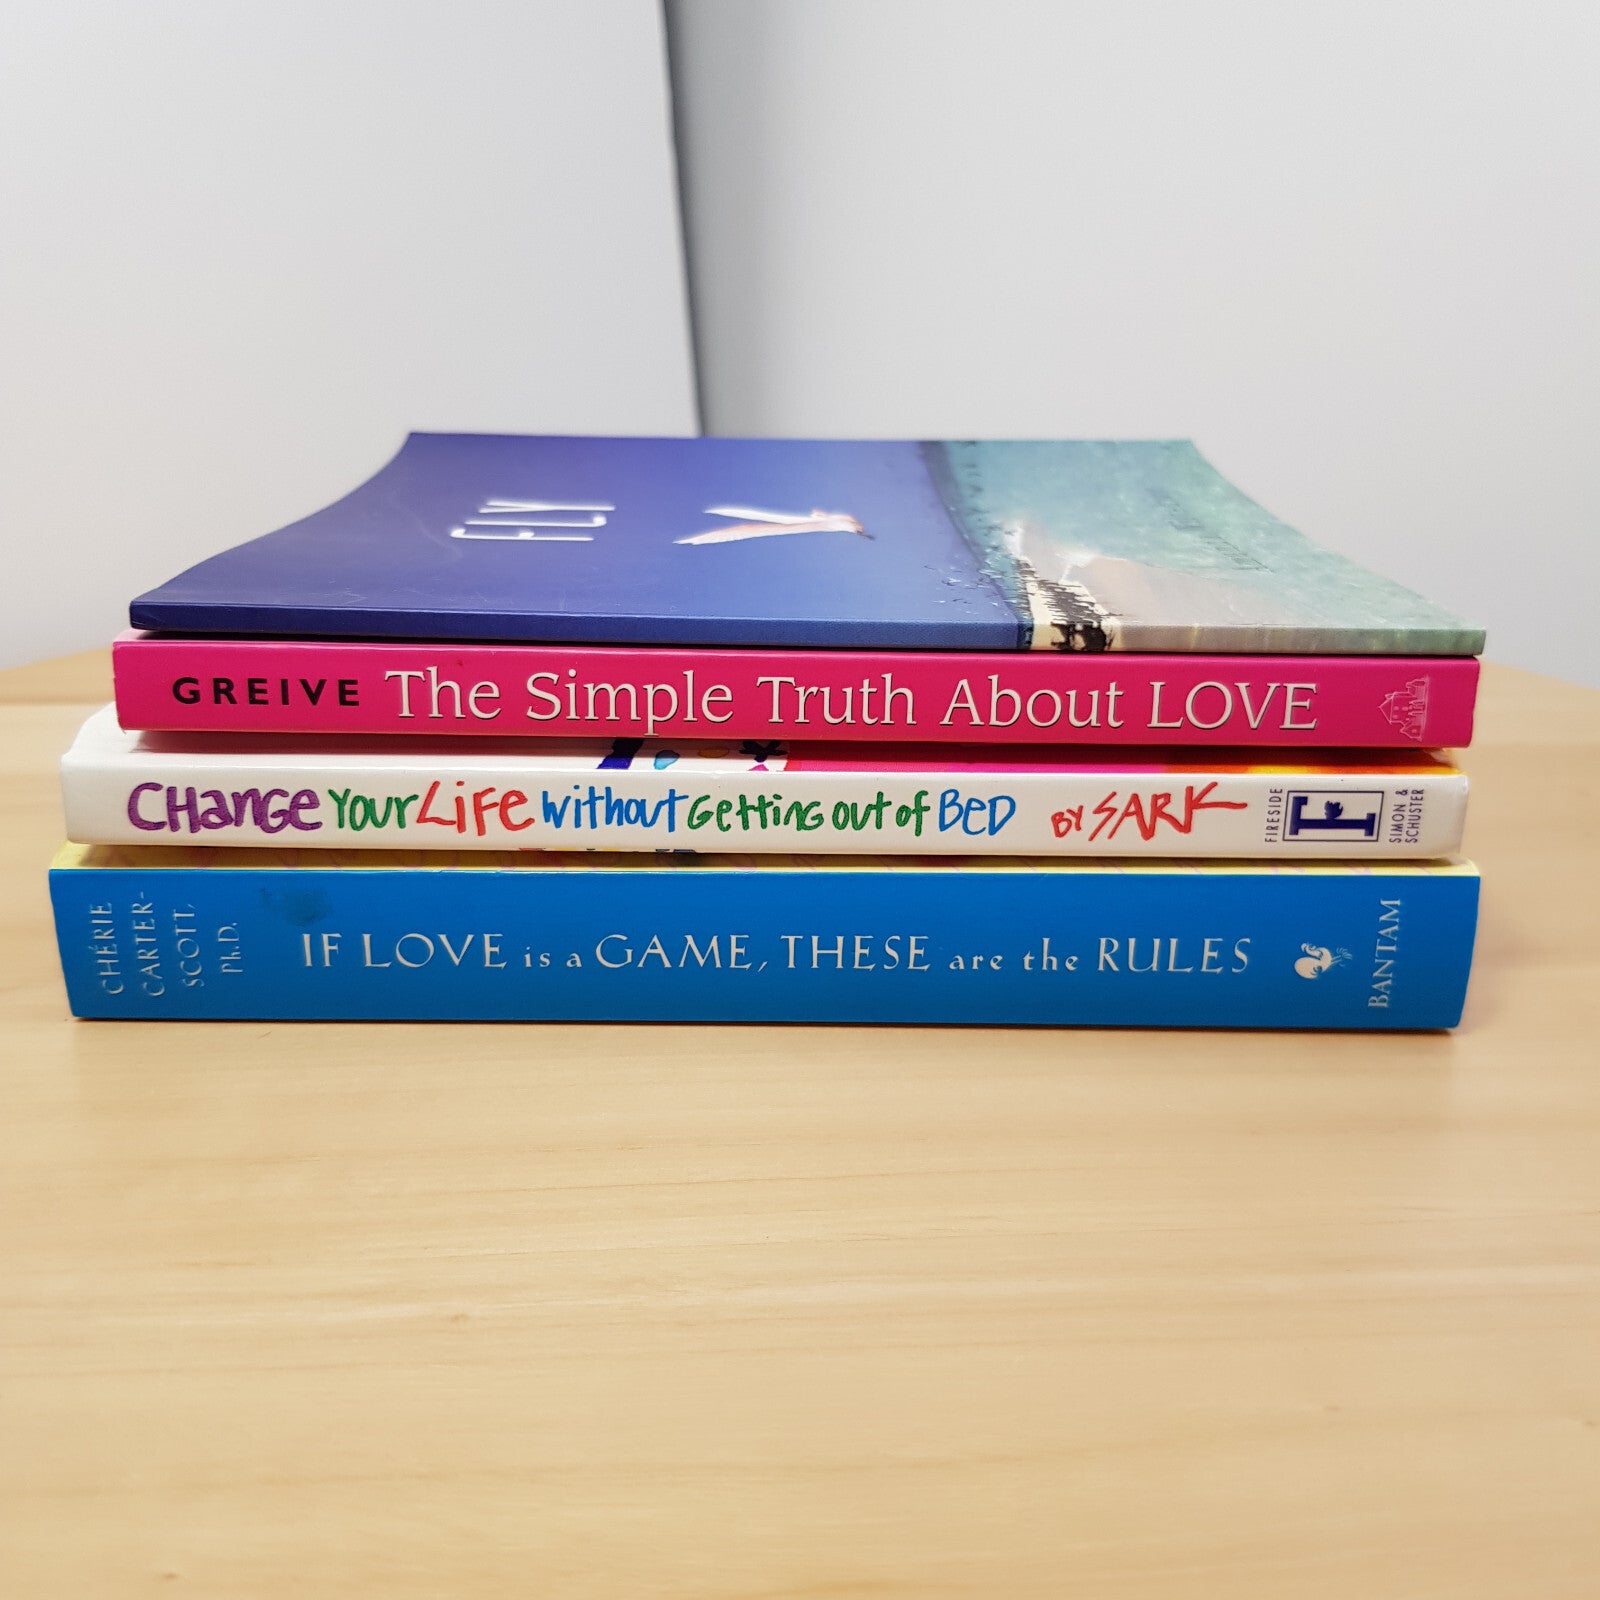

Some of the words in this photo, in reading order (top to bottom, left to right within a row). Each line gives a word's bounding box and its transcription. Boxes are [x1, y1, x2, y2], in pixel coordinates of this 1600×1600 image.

[450, 499, 616, 542] FLY
[171, 675, 361, 708] GREIVE
[384, 666, 502, 720] The
[525, 669, 734, 736] Simple
[757, 673, 917, 726] Truth
[941, 675, 1125, 728] About
[1148, 682, 1318, 730] LOVE
[832, 791, 892, 831] out
[895, 789, 931, 837] of
[1051, 805, 1084, 838] BY
[1088, 781, 1249, 842] SARK
[1264, 787, 1284, 843] FIRESIDE
[1394, 788, 1410, 796] &
[1405, 788, 1426, 844] SCHUSTER
[1389, 803, 1407, 844] SIMON
[88, 901, 125, 995] CHÉRIE
[131, 890, 166, 997] CARTER-
[303, 932, 341, 968] IF
[363, 932, 508, 969] LOVE
[524, 946, 552, 969] is
[565, 953, 583, 969] a
[595, 934, 768, 973] GAME,
[780, 934, 931, 971] THESE
[949, 954, 1005, 971] are
[1023, 937, 1079, 972] the
[1097, 936, 1252, 973] RULES
[1367, 898, 1402, 1008] BANTAM
